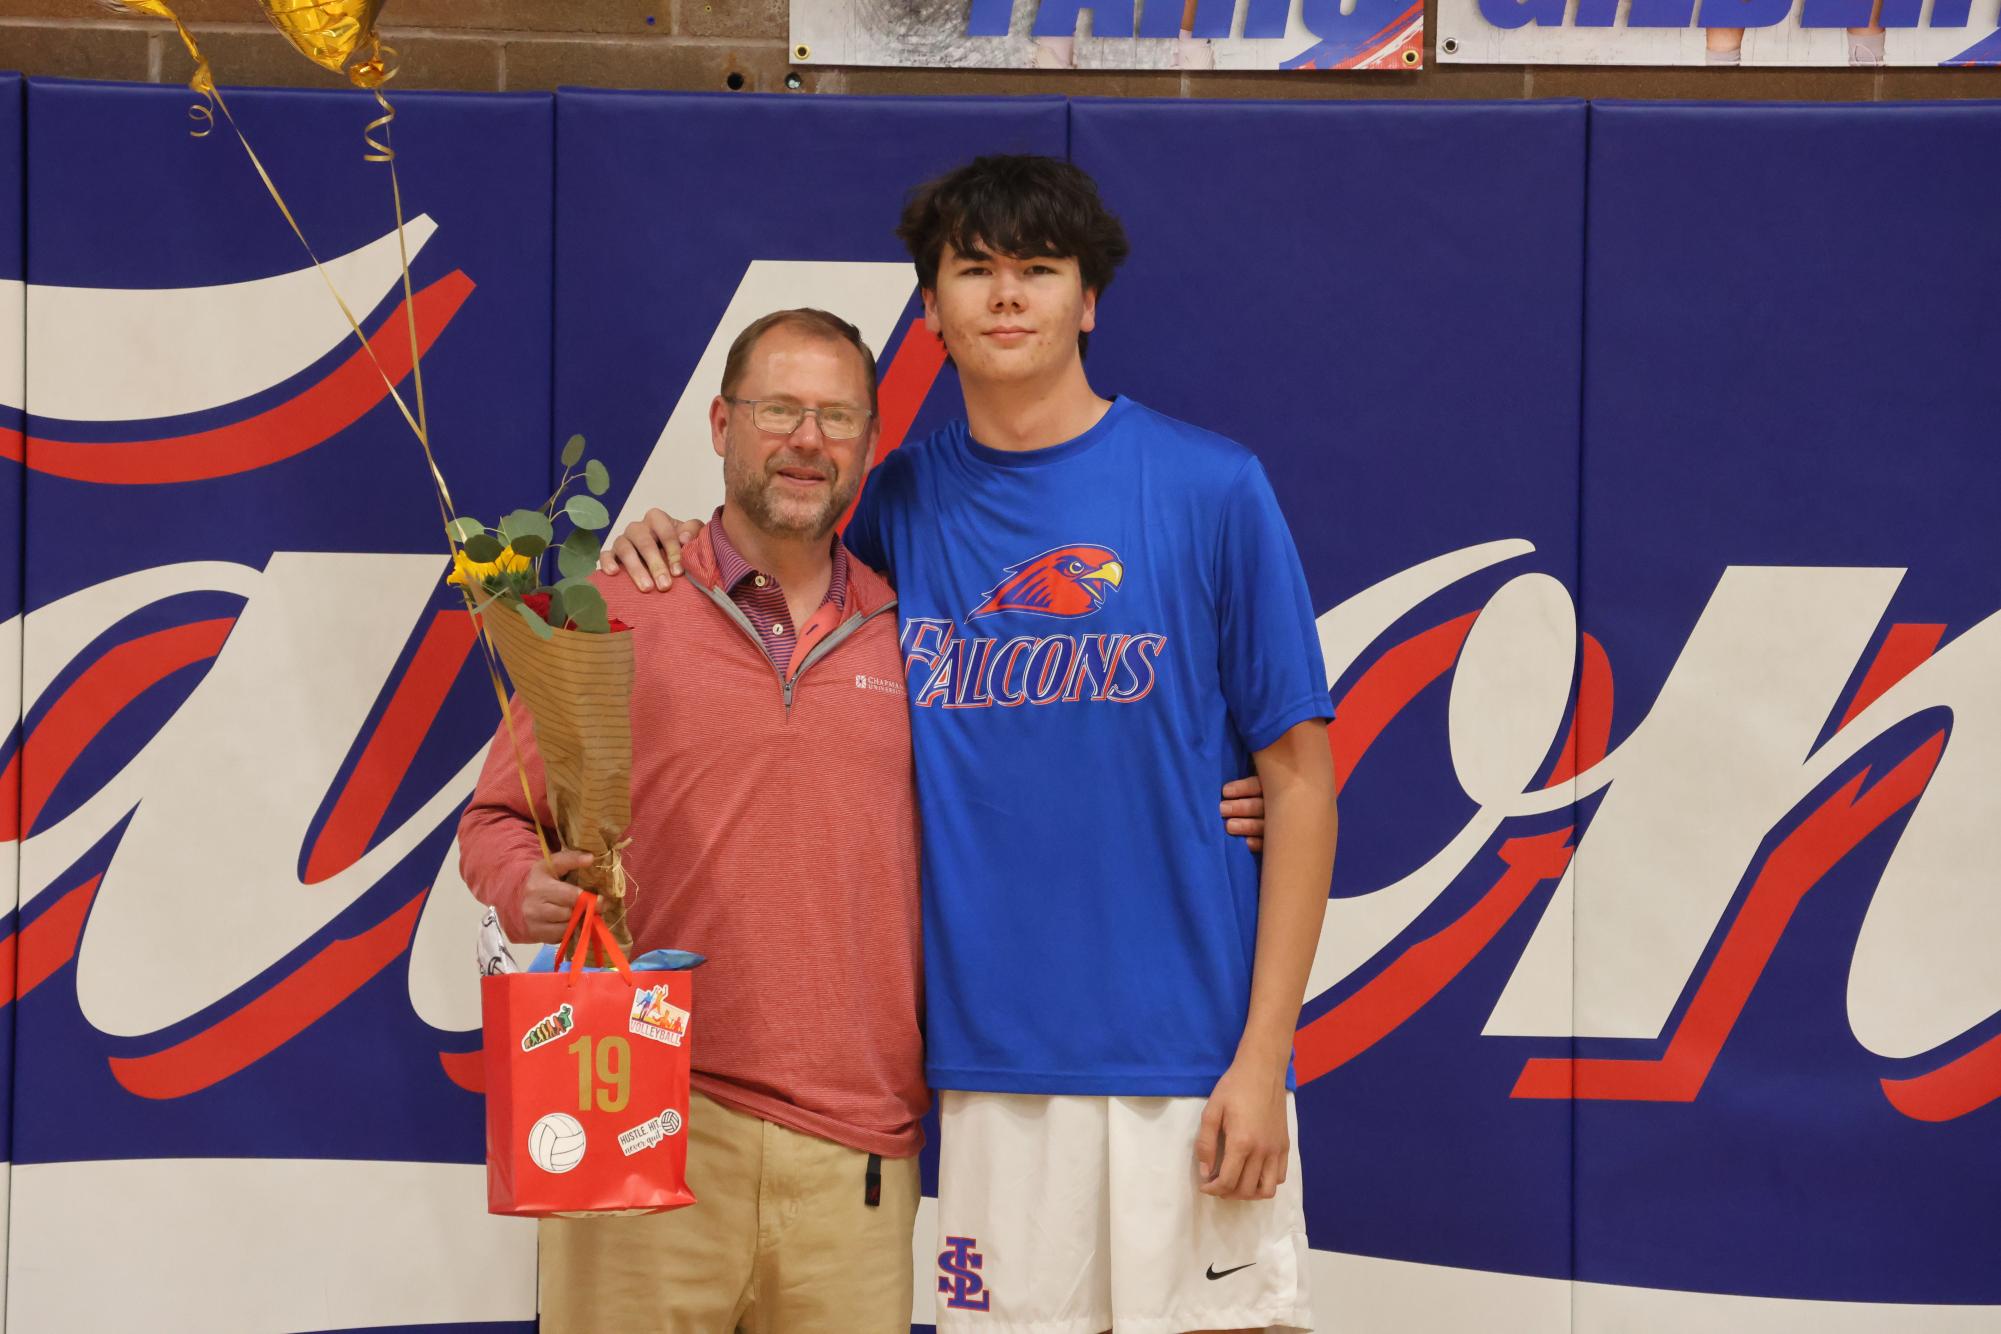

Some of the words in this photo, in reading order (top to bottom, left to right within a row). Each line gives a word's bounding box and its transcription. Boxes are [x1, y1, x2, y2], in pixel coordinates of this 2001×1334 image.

[900, 617, 1167, 709] FALCONS
[630, 1020, 681, 1045] VOLLEYBALL
[568, 1035, 632, 1113] 19
[620, 1126, 649, 1145] HUSTLE.
